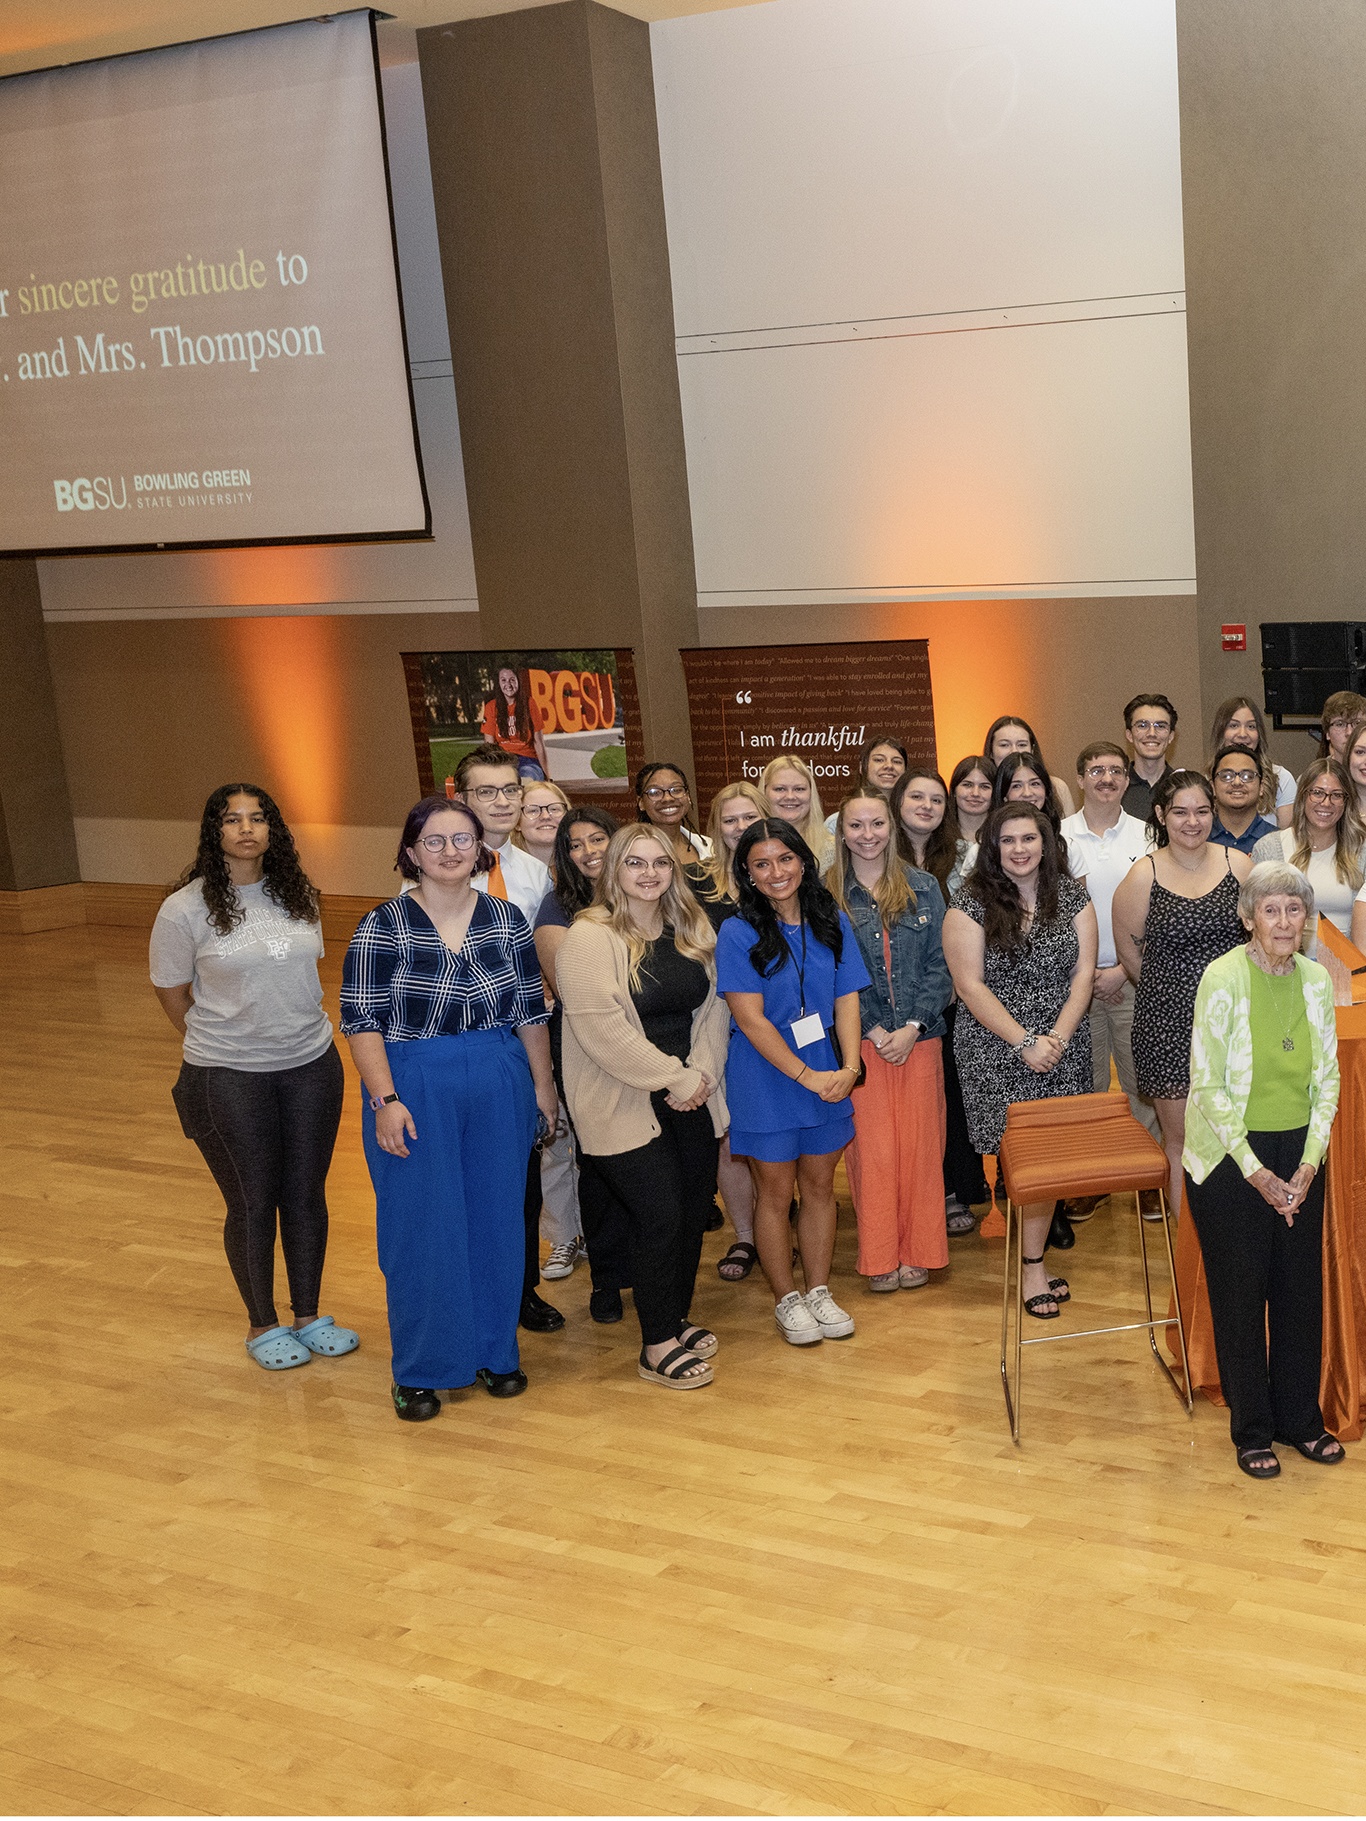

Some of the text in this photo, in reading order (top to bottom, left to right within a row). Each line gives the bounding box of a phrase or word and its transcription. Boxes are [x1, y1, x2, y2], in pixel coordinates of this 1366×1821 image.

[18, 274, 120, 315] sincere
[130, 249, 267, 313] gratitude
[276, 250, 308, 286] to
[18, 324, 325, 380] and Mrs. Thompson
[134, 469, 251, 491] BOWLING GREEN
[53, 477, 127, 512] BGSU
[137, 492, 253, 509] STATE UNIVERSITY
[845, 655, 866, 664] bigger
[528, 669, 615, 734] BGSU
[867, 688, 883, 696] loved
[885, 688, 902, 696] being
[740, 730, 744, 747] I
[750, 735, 775, 747] am
[780, 726, 866, 752] thankful
[218, 928, 257, 959] STATE
